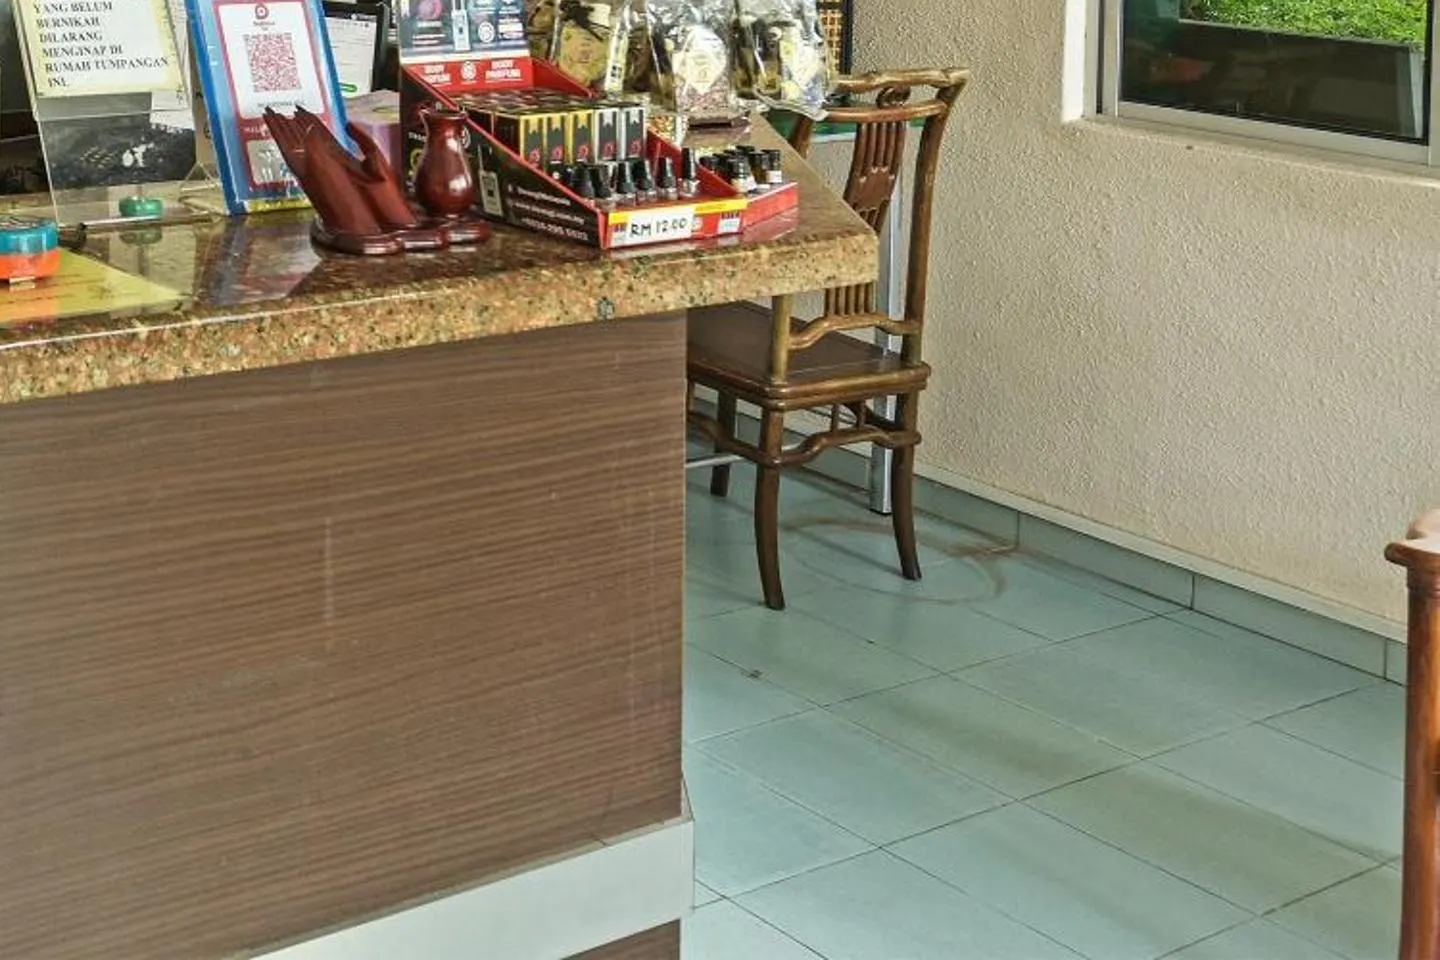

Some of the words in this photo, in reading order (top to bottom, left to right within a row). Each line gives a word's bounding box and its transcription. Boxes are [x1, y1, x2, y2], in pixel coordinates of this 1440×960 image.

[33, 2, 69, 14] YANG
[70, 1, 113, 12] BELUM
[36, 16, 101, 29] BERNIKAH
[39, 31, 103, 43] DILARANG
[42, 45, 106, 58] MENGINAP
[109, 44, 123, 55] DI
[45, 60, 92, 74] RUMAH
[95, 56, 169, 70] TUMPANGAN
[630, 223, 652, 237] RM
